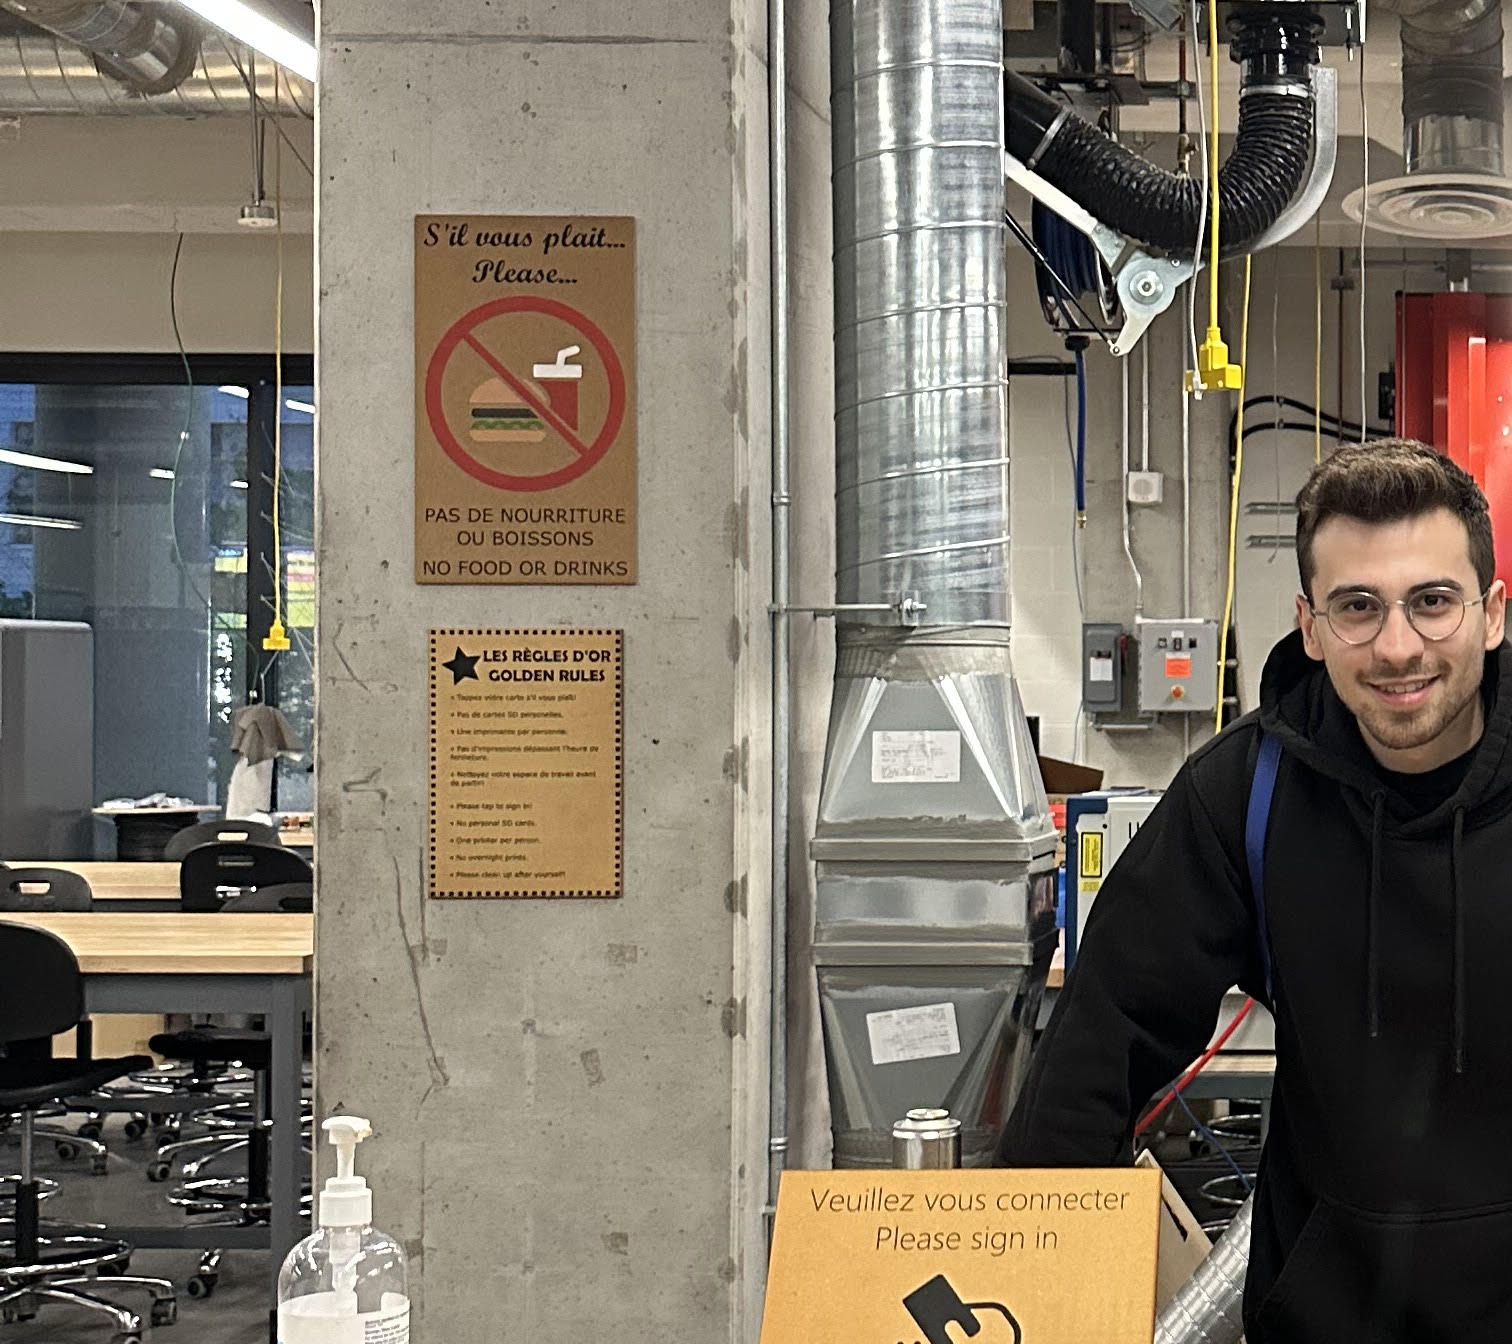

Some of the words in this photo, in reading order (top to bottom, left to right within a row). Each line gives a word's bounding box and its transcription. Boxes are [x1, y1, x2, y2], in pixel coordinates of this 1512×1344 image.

[423, 223, 469, 248] S'il
[475, 231, 533, 248] vous
[472, 259, 578, 284] Please...
[425, 507, 460, 524] PAS
[468, 507, 494, 524] DE
[501, 507, 626, 524] NOURRITURE
[457, 530, 485, 547] OU
[493, 530, 594, 547] BOISSONS
[423, 561, 451, 577] NO
[458, 561, 512, 577] FOOD
[519, 561, 546, 577] OR
[554, 561, 628, 577] DRINKS
[483, 650, 508, 662] LES
[512, 647, 568, 663] RÈGLES
[573, 650, 611, 662] D'OR
[489, 669, 554, 682] GOLDEN
[558, 669, 606, 682] RULES
[811, 1188, 915, 1212] Veuillez
[926, 1193, 987, 1212] vous
[996, 1189, 1130, 1212] connecter
[876, 1226, 961, 1251] Please
[971, 1226, 1025, 1256] sign
[1036, 1227, 1058, 1250] in
